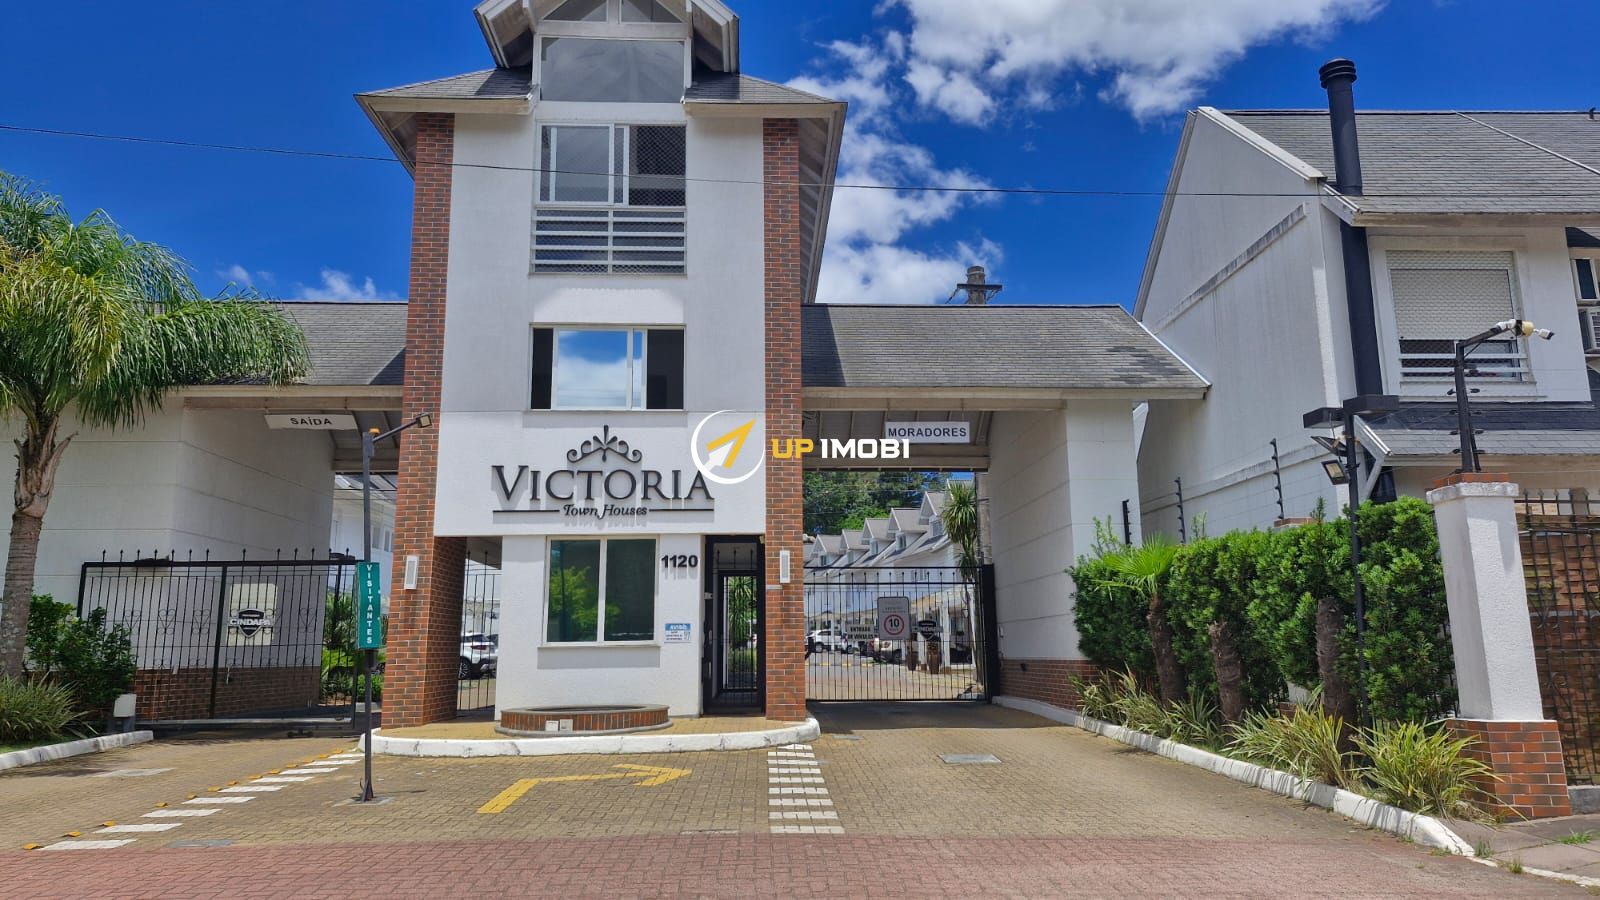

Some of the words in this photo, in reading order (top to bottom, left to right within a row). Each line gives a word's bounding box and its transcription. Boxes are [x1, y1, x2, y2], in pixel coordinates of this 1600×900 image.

[290, 416, 333, 426] SAÍDA
[888, 427, 967, 438] MORADORES
[492, 465, 714, 500] VICTORIA
[563, 503, 598, 517] Town
[597, 503, 648, 520] Houses
[661, 554, 699, 569] 1120
[366, 564, 374, 644] VISITANTES
[888, 618, 900, 628] 10
